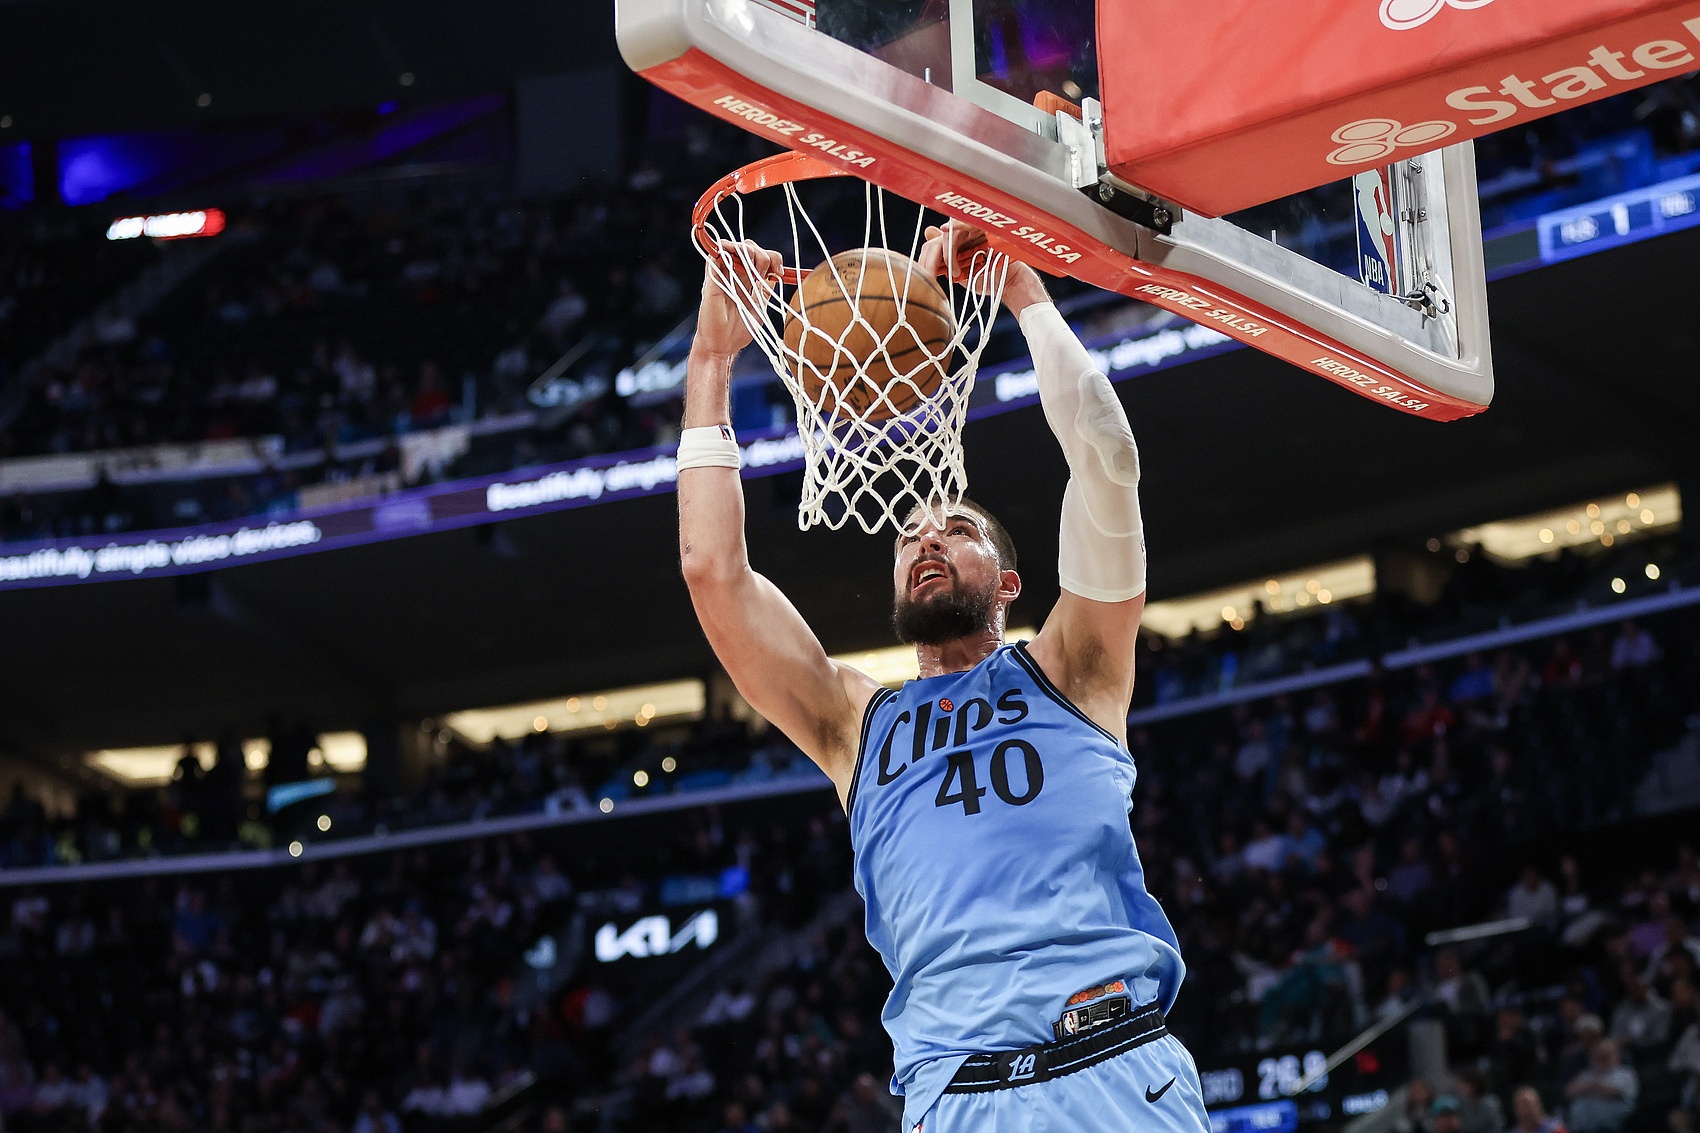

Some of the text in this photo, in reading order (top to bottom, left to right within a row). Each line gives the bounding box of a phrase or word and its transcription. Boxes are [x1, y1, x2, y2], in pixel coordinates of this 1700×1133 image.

[713, 95, 877, 169] HERDEZ SALSA
[935, 191, 1082, 265] HERDEZ SALSA
[1364, 254, 1385, 286] NBA
[1135, 284, 1269, 338] HERDEZ SALSA
[1310, 356, 1430, 412] HERDEZ SALSA
[0, 546, 94, 580] eautifully
[877, 688, 1029, 786] Clips
[935, 738, 1044, 816] 40
[595, 908, 718, 962] KIA
[1007, 1053, 1036, 1082] LA
